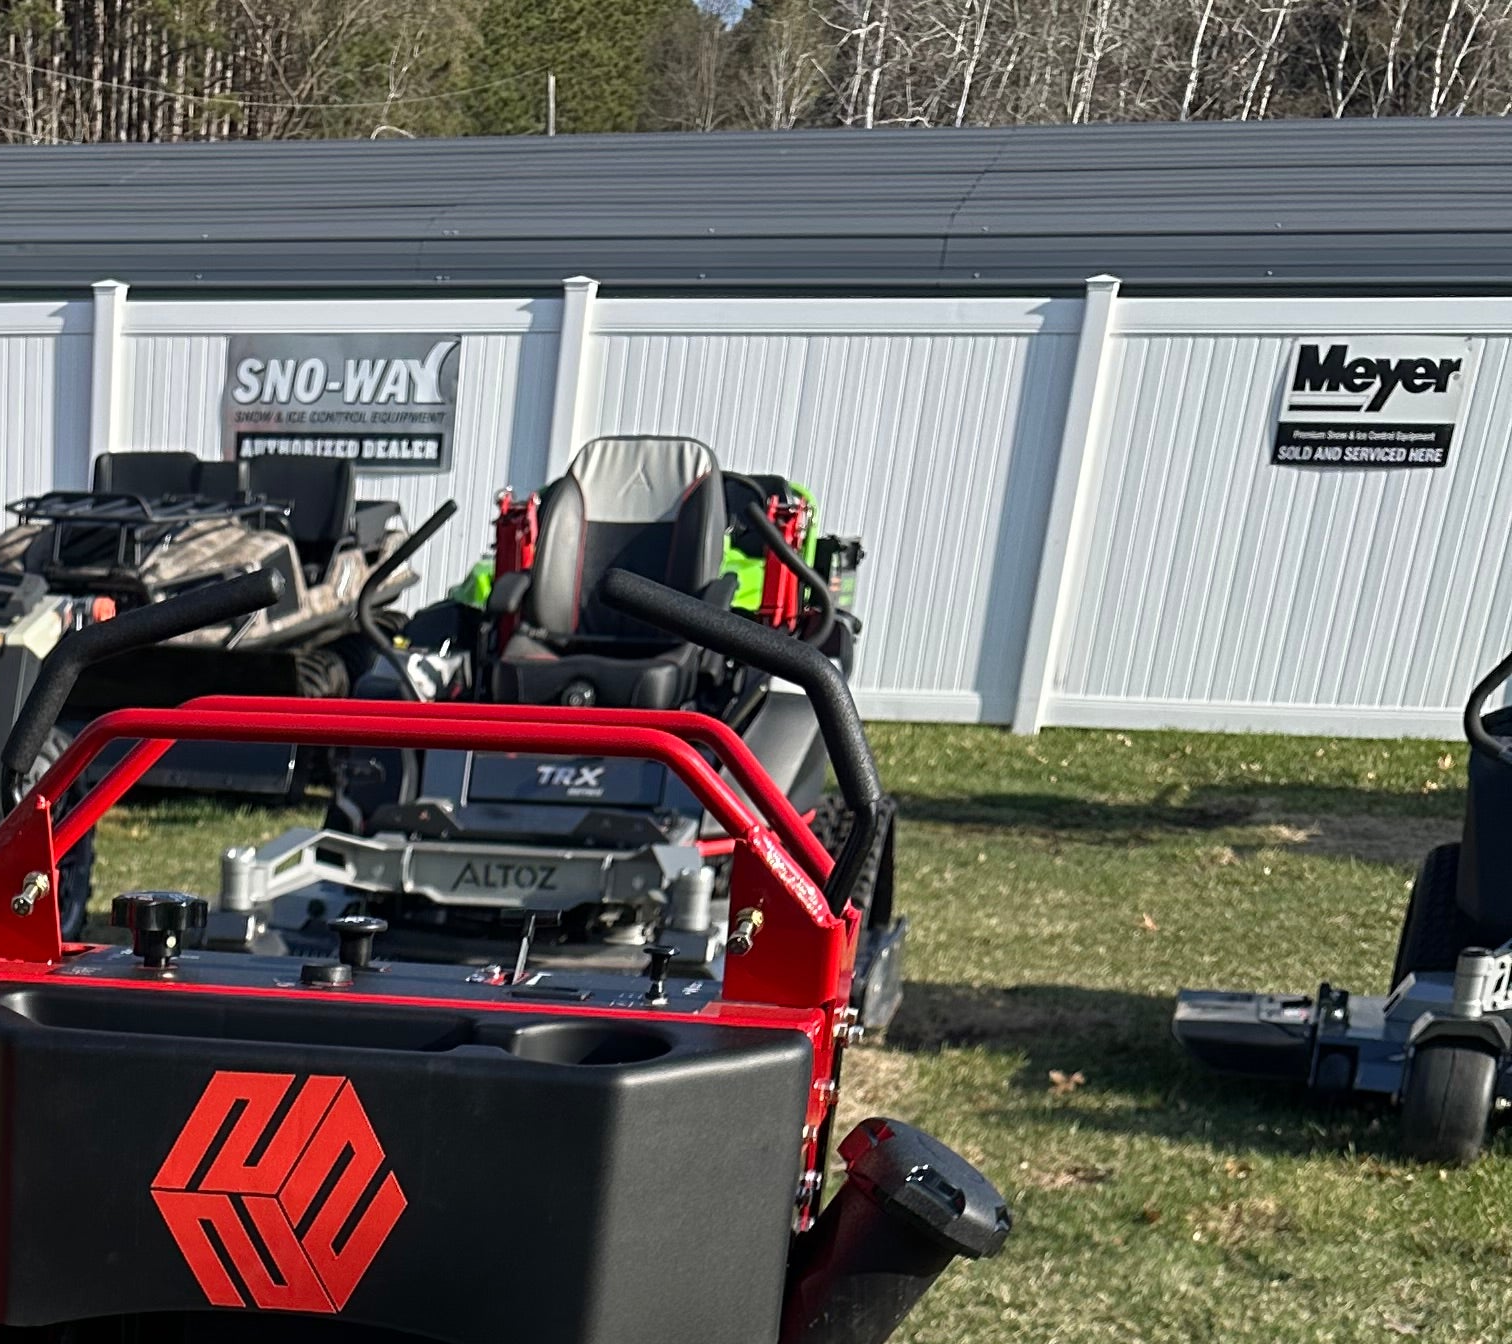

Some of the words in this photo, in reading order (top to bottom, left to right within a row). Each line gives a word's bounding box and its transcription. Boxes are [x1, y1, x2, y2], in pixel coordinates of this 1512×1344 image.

[232, 341, 458, 404] SNO-WAY
[1292, 344, 1462, 412] Meyer
[288, 411, 307, 424] ICE
[309, 411, 367, 424] CONTROL
[371, 411, 446, 424] EQUIPMENT
[240, 439, 360, 458] AUTHORIZED
[362, 439, 439, 459] DEALER
[1277, 446, 1312, 461] SOLD
[1313, 446, 1342, 461] AND
[1344, 447, 1407, 462] SERVICED
[1408, 448, 1443, 463] HERE
[537, 765, 604, 786] TRX
[451, 860, 558, 891] ALTOZ
